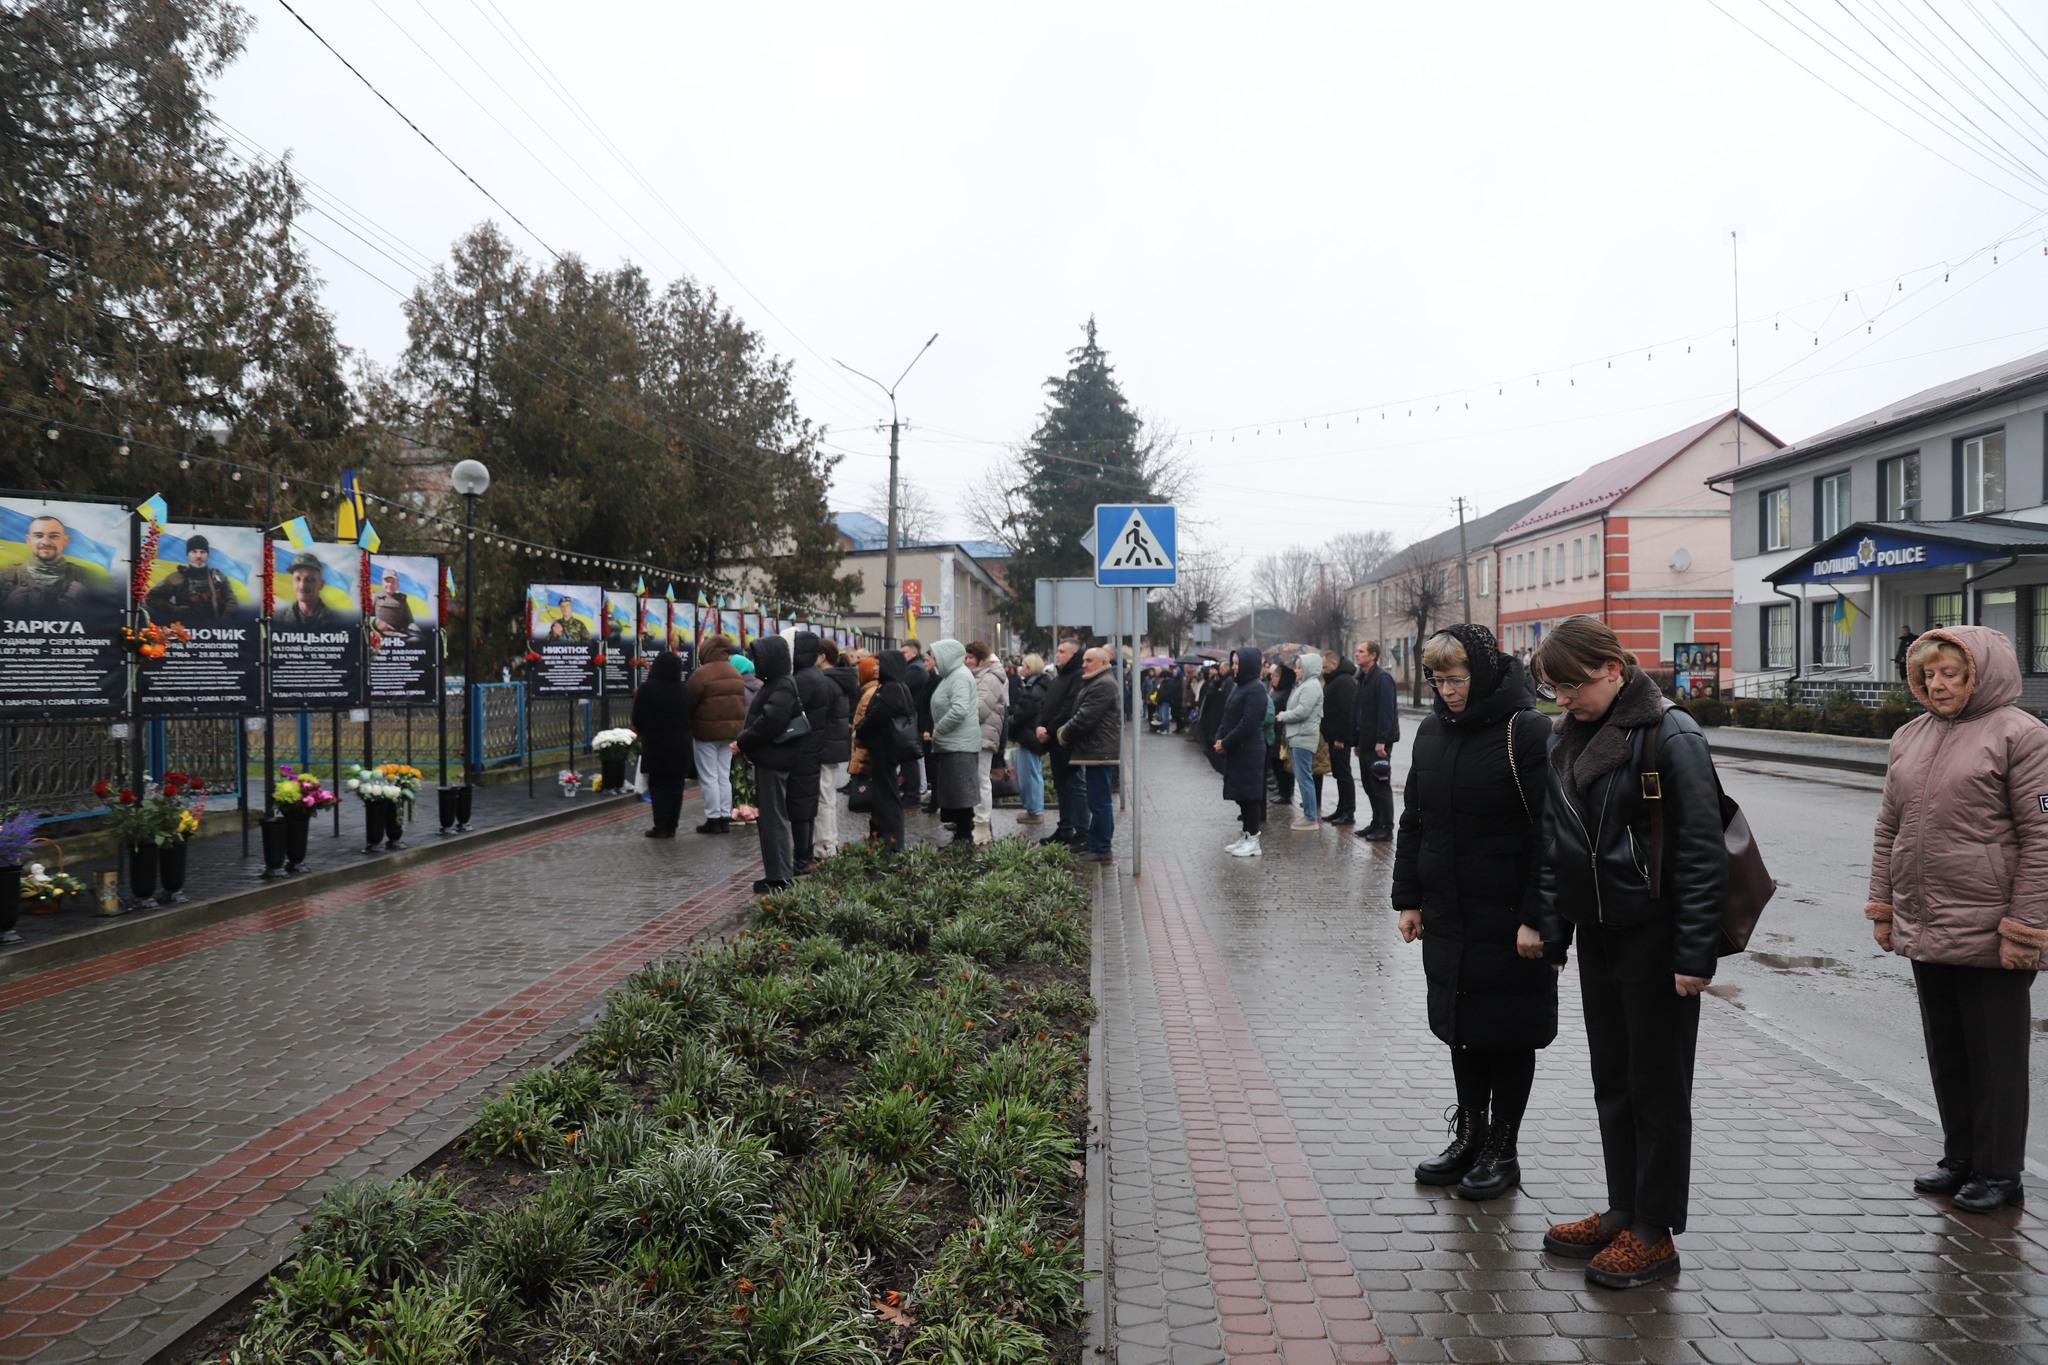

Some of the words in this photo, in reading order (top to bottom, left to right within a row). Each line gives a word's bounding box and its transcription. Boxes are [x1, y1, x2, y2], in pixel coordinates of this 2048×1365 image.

[1877, 546, 1926, 567] POLICE
[1813, 556, 1859, 576] ПОЛІЦІЯ
[3, 619, 86, 634] ЗАРКУА
[271, 631, 350, 645] АЛИЦЬКИЙ
[542, 646, 589, 654] НИКИТЮК
